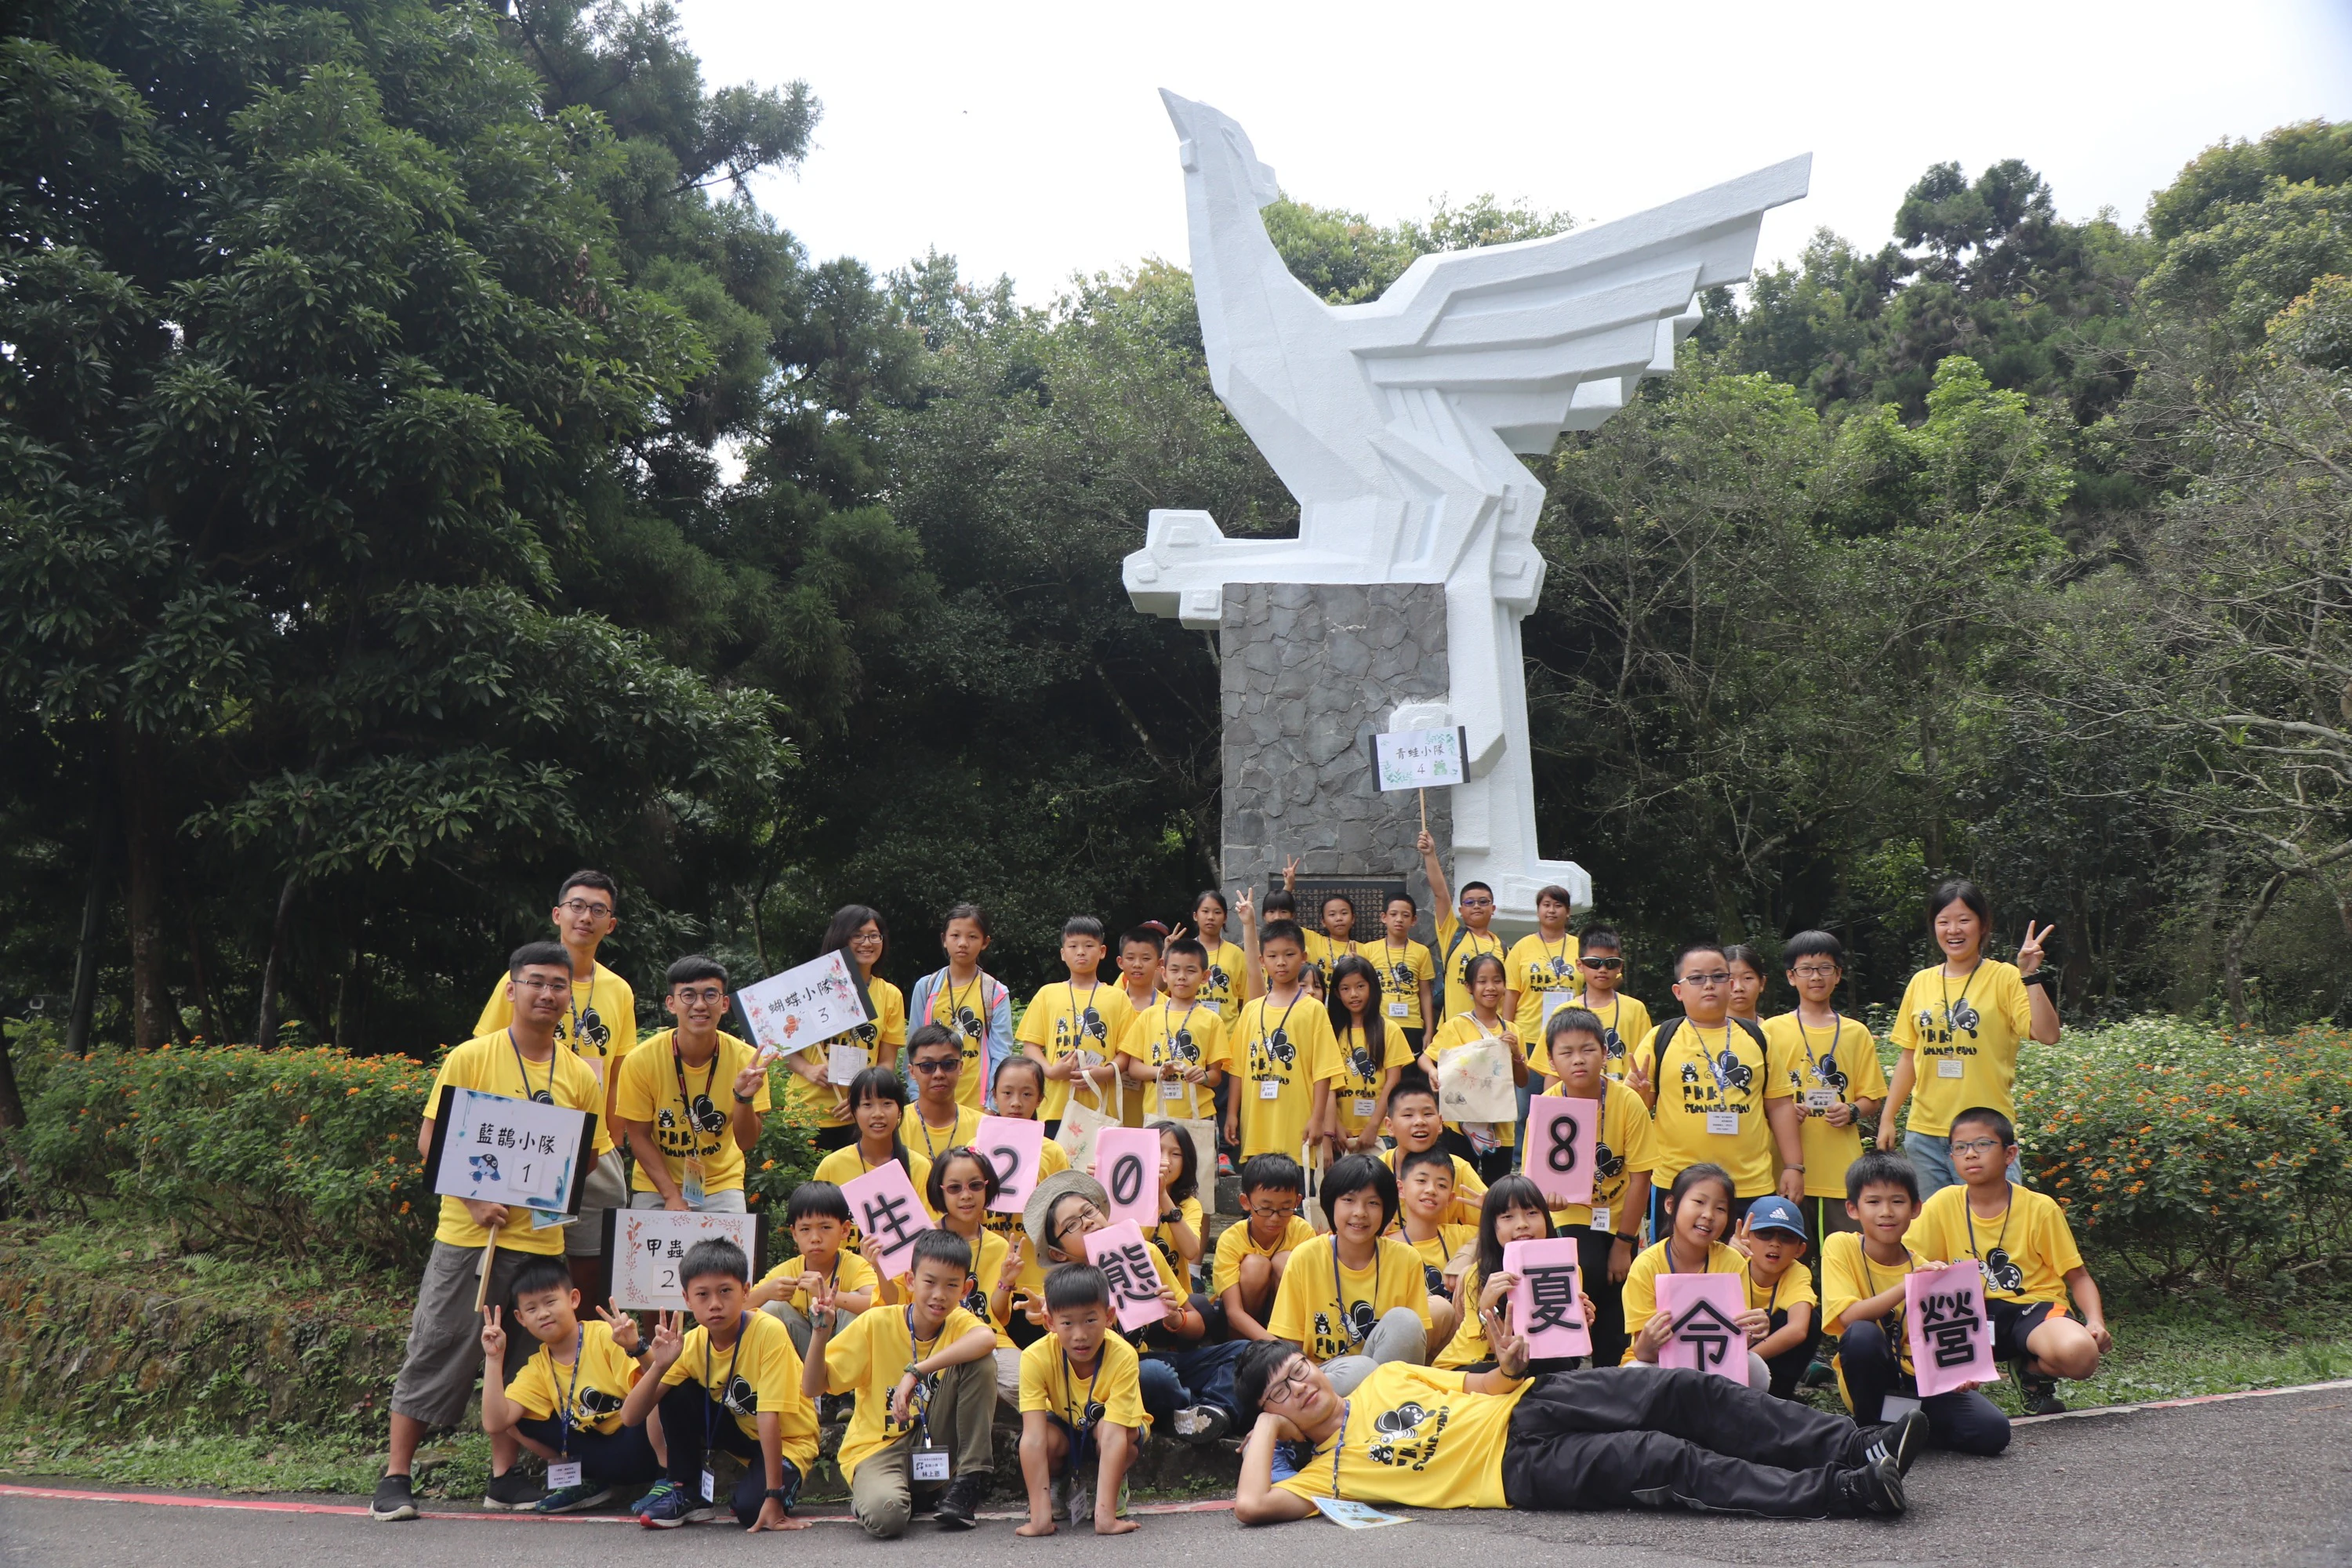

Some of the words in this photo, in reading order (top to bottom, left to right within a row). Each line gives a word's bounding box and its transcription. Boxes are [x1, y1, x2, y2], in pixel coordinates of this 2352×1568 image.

[1396, 744, 1445, 760] 青蛙小隊
[1417, 764, 1425, 775] 4
[768, 978, 834, 1014] 蝴蝶小隊
[818, 1007, 829, 1023] 3
[476, 1123, 556, 1155] 藍鵲小隊
[1549, 1116, 1577, 1172] 8
[522, 1162, 532, 1183] 1
[993, 1147, 1019, 1195] 2
[1112, 1155, 1142, 1205] 0
[864, 1194, 927, 1256] 生
[647, 1239, 684, 1258] 甲蟲
[662, 1269, 675, 1289] 2
[1098, 1243, 1157, 1310] 態
[1523, 1265, 1582, 1334] 夏
[1671, 1300, 1742, 1372] 令
[1920, 1291, 1980, 1368] 營
